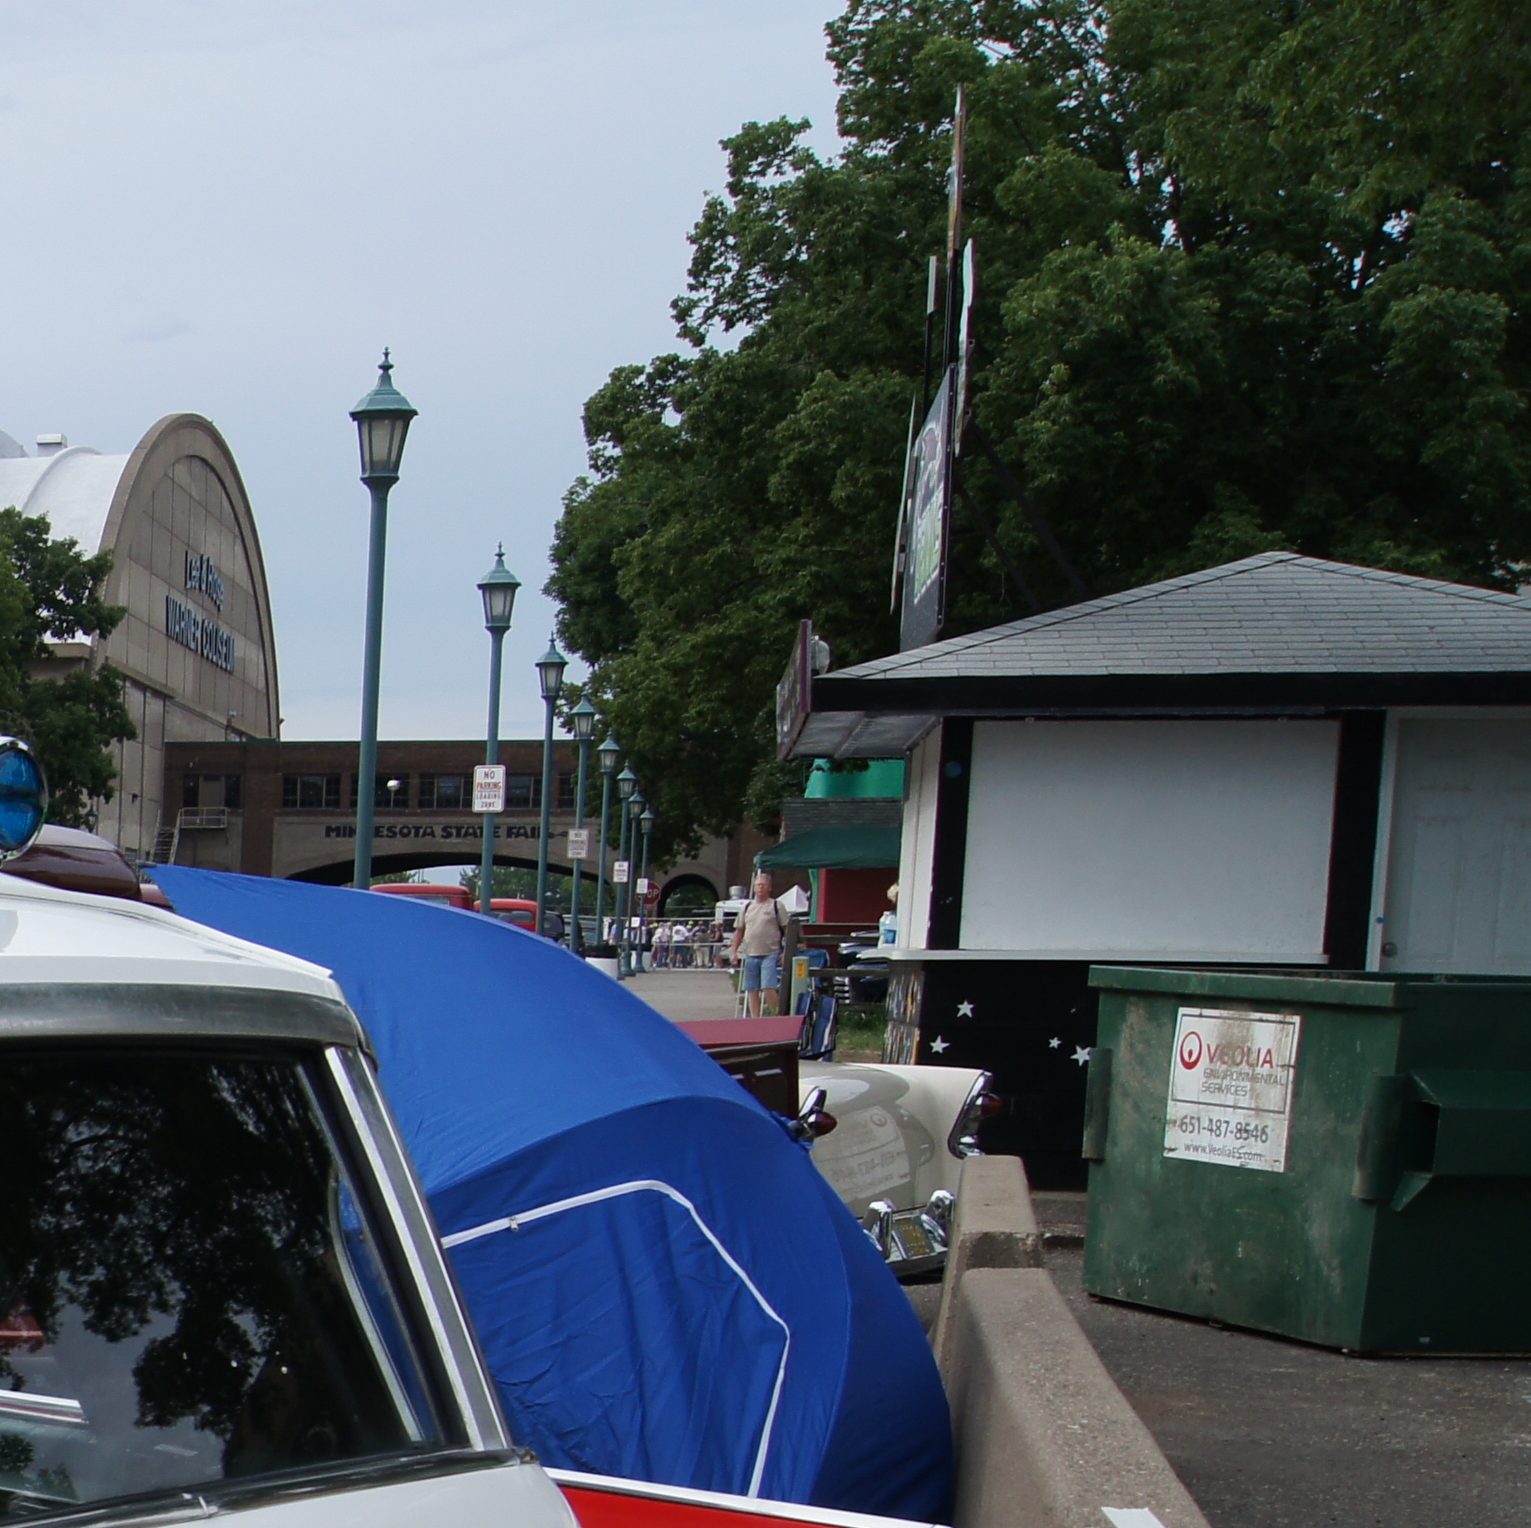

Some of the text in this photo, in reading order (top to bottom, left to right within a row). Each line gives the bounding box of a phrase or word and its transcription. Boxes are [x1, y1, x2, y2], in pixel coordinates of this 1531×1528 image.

[483, 770, 496, 780] NO
[476, 781, 502, 791] PARKING
[324, 825, 436, 839] MINESOTA
[1206, 1043, 1275, 1070] VEOLIA
[1203, 1067, 1285, 1087] ENVIRONMENTAL
[1201, 1081, 1249, 1097] SERVICES
[1179, 1114, 1269, 1144] 651-487-8546
